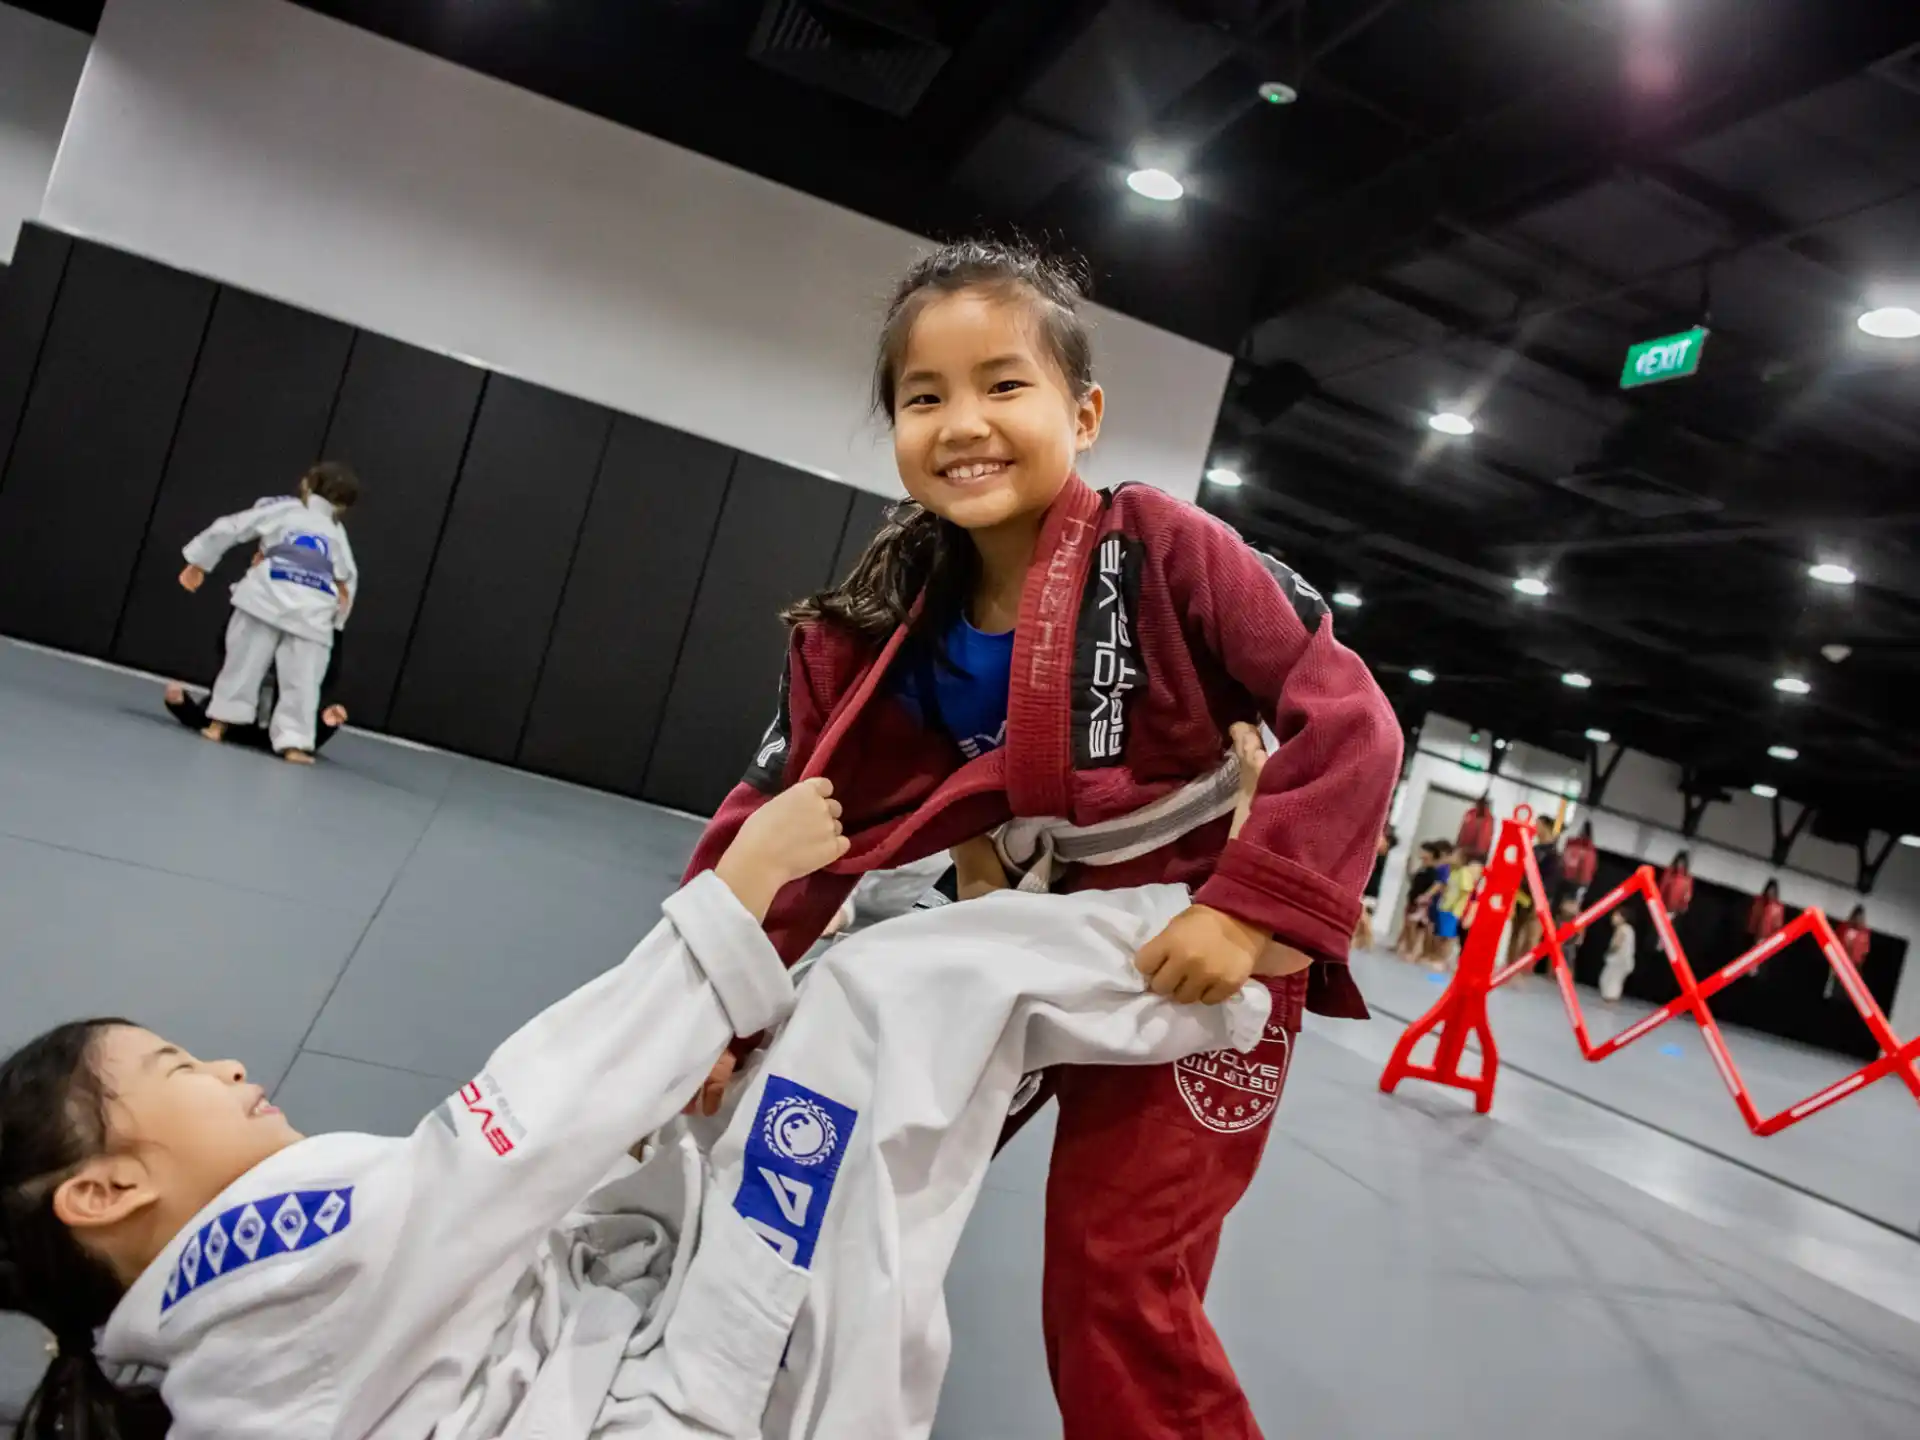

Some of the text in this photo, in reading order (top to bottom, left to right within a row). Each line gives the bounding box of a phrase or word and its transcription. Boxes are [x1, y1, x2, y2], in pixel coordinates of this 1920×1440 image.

[1641, 338, 1692, 376] EXIT
[1089, 539, 1121, 758] EVOLVE
[1109, 658, 1136, 757] FIGHT
[1183, 1056, 1277, 1092] JIU JITSU
[1198, 1050, 1279, 1079] VOLVE
